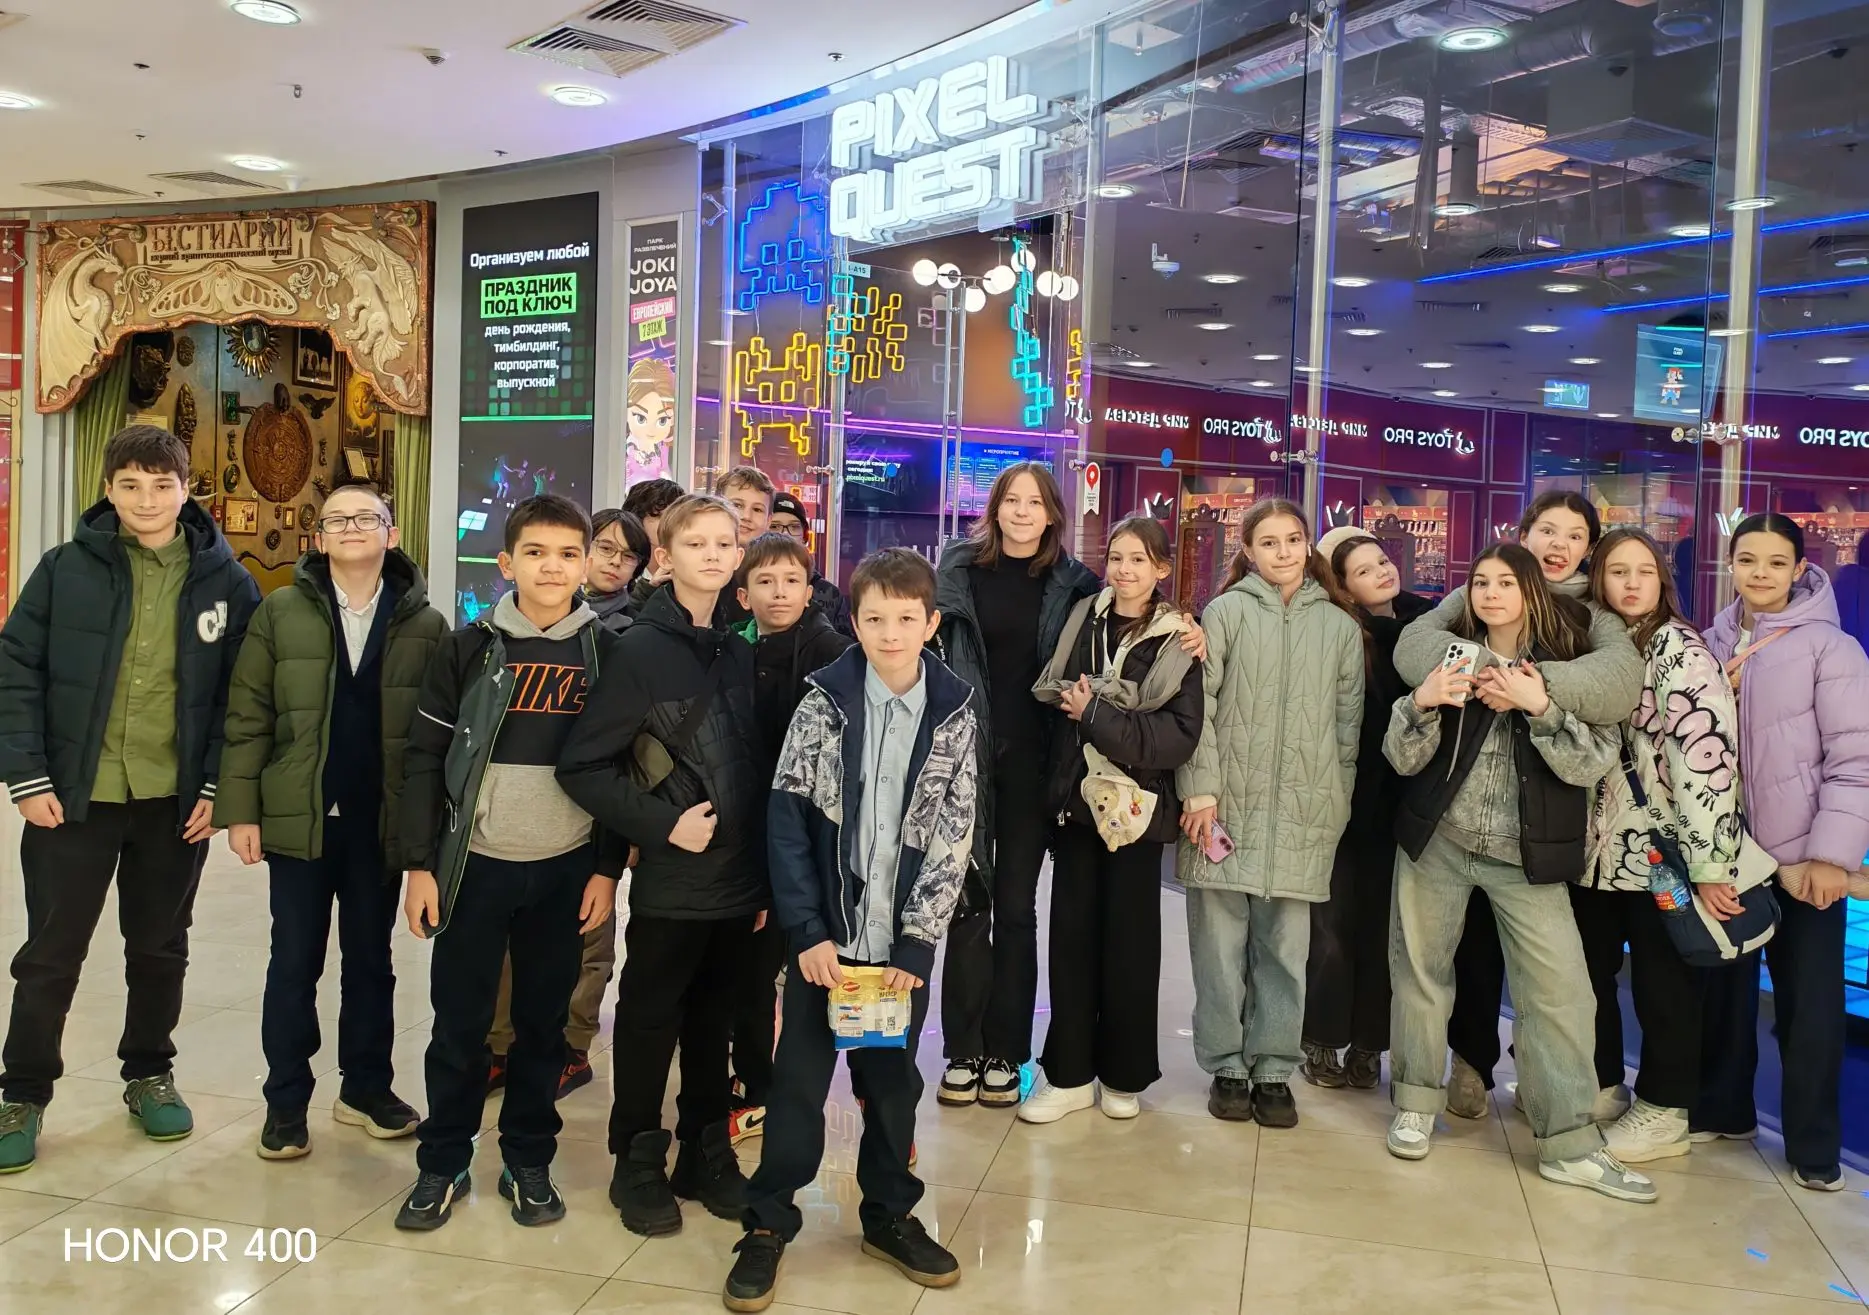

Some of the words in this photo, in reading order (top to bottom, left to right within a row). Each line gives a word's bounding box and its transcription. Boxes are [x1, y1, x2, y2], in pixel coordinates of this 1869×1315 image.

[831, 55, 1039, 168] PIXEL
[830, 126, 1039, 240] QUEST
[470, 249, 544, 269] Организуем
[546, 242, 590, 260] любой
[630, 257, 675, 275] JOKI
[485, 277, 573, 298] ПРАЗДНИК
[630, 276, 677, 295] JOYA
[484, 299, 519, 316] ПОД
[522, 295, 573, 312] КЛЮЧ
[633, 299, 674, 320] ЕВРОПЕЙСКИЙ
[484, 326, 511, 338] день
[512, 322, 571, 337] рождения,
[646, 320, 663, 336] ЭТАЖ
[494, 340, 560, 353] тимбилдинг,
[494, 359, 560, 373] корпоратив,
[496, 374, 556, 391] выпускной
[505, 663, 588, 714] NIKE
